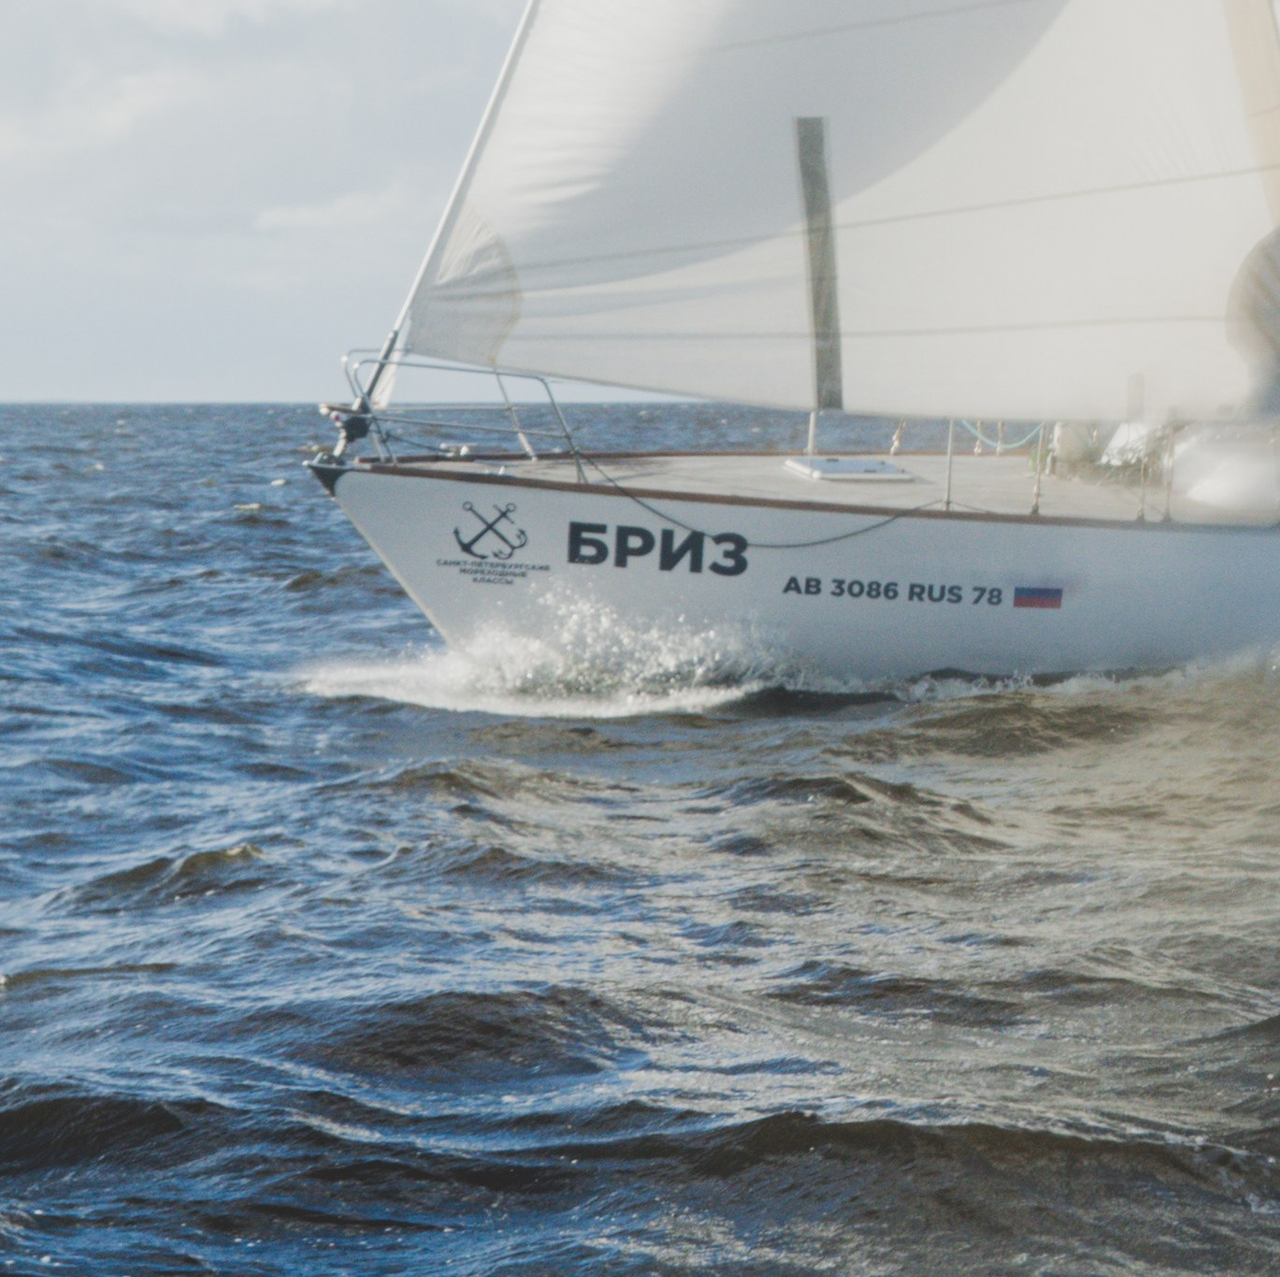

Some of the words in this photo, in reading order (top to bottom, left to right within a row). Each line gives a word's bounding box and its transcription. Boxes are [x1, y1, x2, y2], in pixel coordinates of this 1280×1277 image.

[567, 521, 748, 576] БРИЗ
[830, 578, 899, 600] 3086
[908, 583, 962, 604] RUS
[972, 587, 1003, 606] 78
